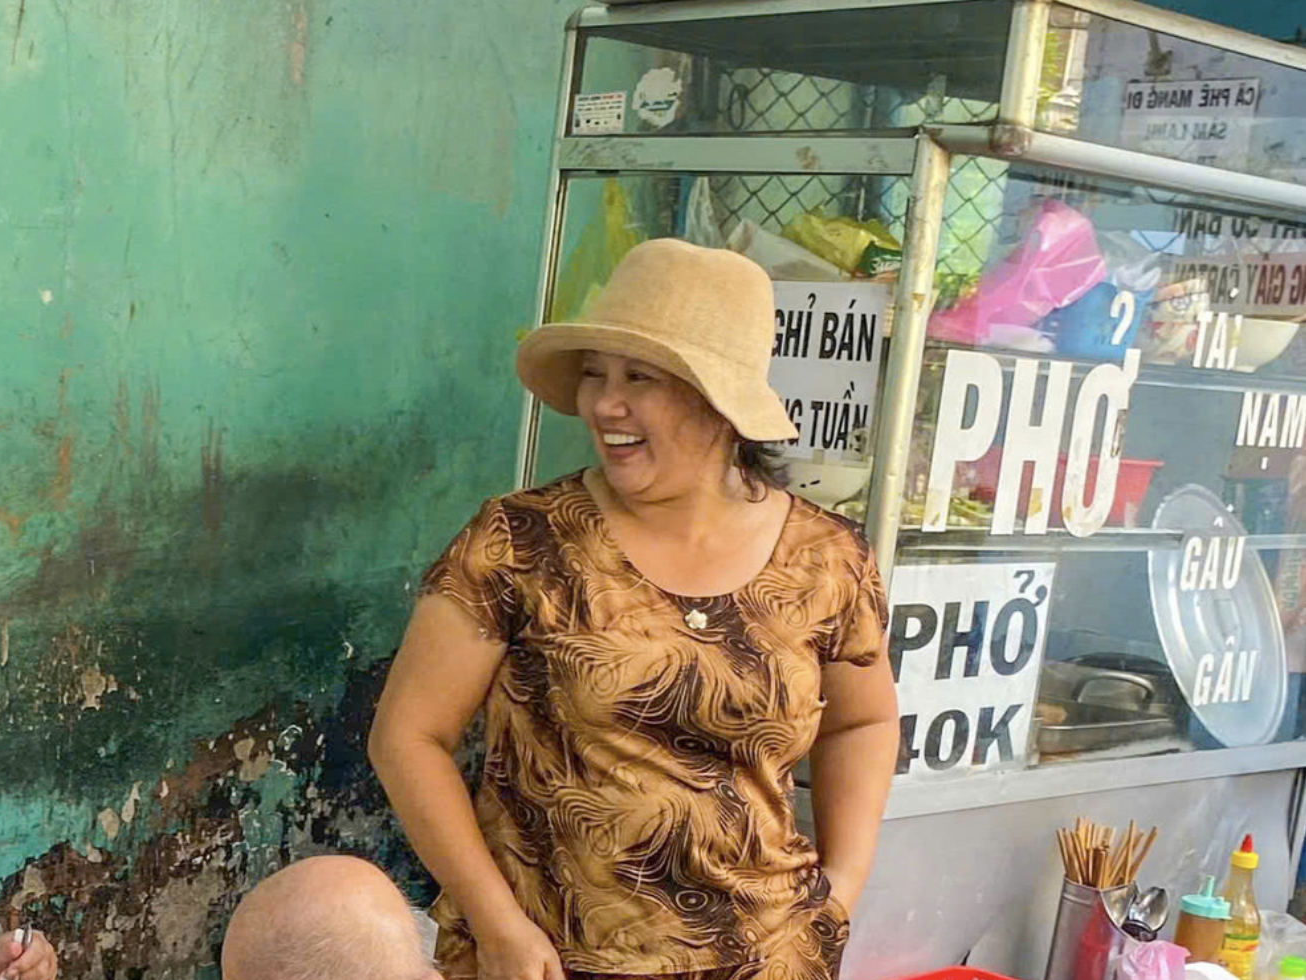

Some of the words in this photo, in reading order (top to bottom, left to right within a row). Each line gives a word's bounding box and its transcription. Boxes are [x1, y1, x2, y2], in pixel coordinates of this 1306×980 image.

[819, 299, 876, 362] BÁN
[922, 290, 1141, 538] PHỞ
[888, 569, 1048, 684] PHỞ
